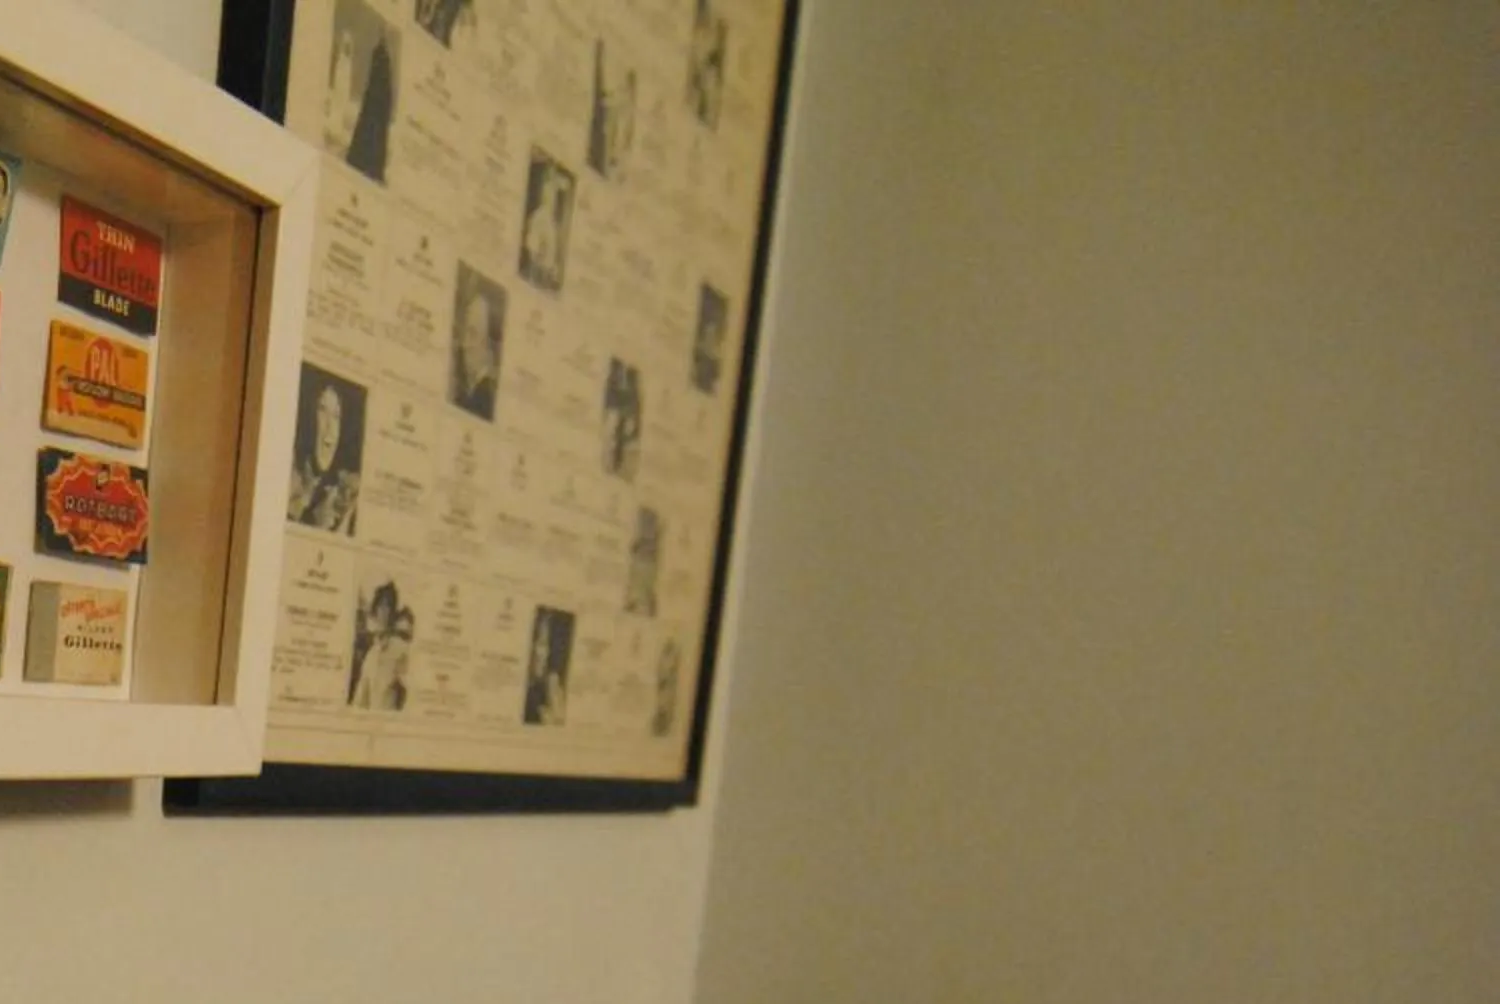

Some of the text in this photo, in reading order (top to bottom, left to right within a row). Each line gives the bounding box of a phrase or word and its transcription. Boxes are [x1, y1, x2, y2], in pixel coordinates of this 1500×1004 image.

[96, 220, 136, 254] THIN
[70, 229, 156, 297] Gillette
[93, 287, 130, 316] BLADE
[90, 345, 117, 386] PAL
[64, 634, 122, 651] Gillette
